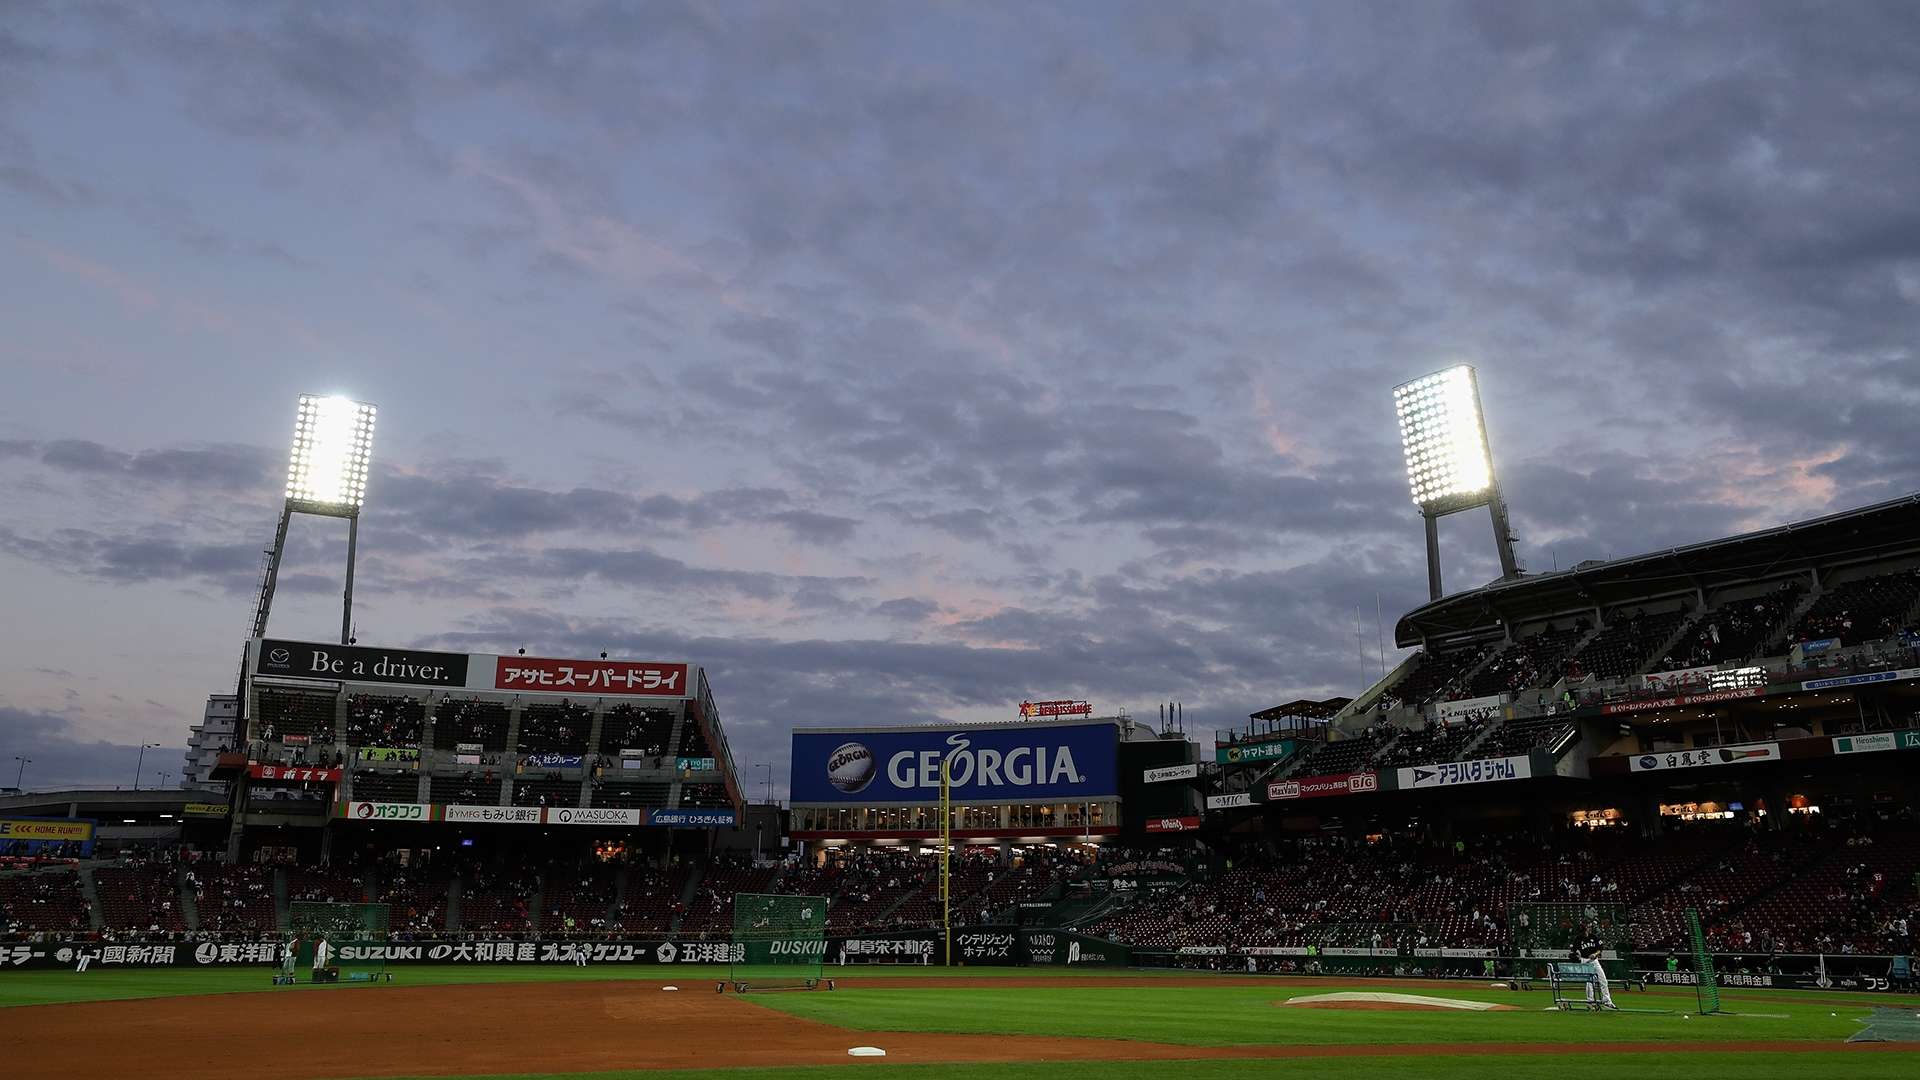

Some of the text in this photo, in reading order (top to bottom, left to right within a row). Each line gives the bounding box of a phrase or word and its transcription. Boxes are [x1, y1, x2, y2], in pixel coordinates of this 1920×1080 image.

[310, 650, 448, 681] Be a driver.
[504, 667, 679, 689] アサヒスーパードライ
[829, 749, 868, 772] GEORGIA
[888, 733, 1078, 788] GEORGIA
[374, 806, 421, 817] オタフク
[454, 811, 480, 820] YMFG
[482, 809, 537, 821] もみじ銀行
[574, 810, 629, 820] MASUOKA
[34, 826, 57, 834] HOME
[957, 934, 1015, 945] インテリジェント
[219, 944, 289, 963] 東洋証
[340, 947, 422, 960] SUZUKI
[453, 943, 535, 961] 大和興産
[681, 943, 745, 962] 五洋建設
[770, 941, 828, 954] DUSKIN
[964, 947, 1008, 957] ホテルズ
[77, 946, 175, 963] 國新聞
[1724, 975, 1772, 986] 呉信用金庫
